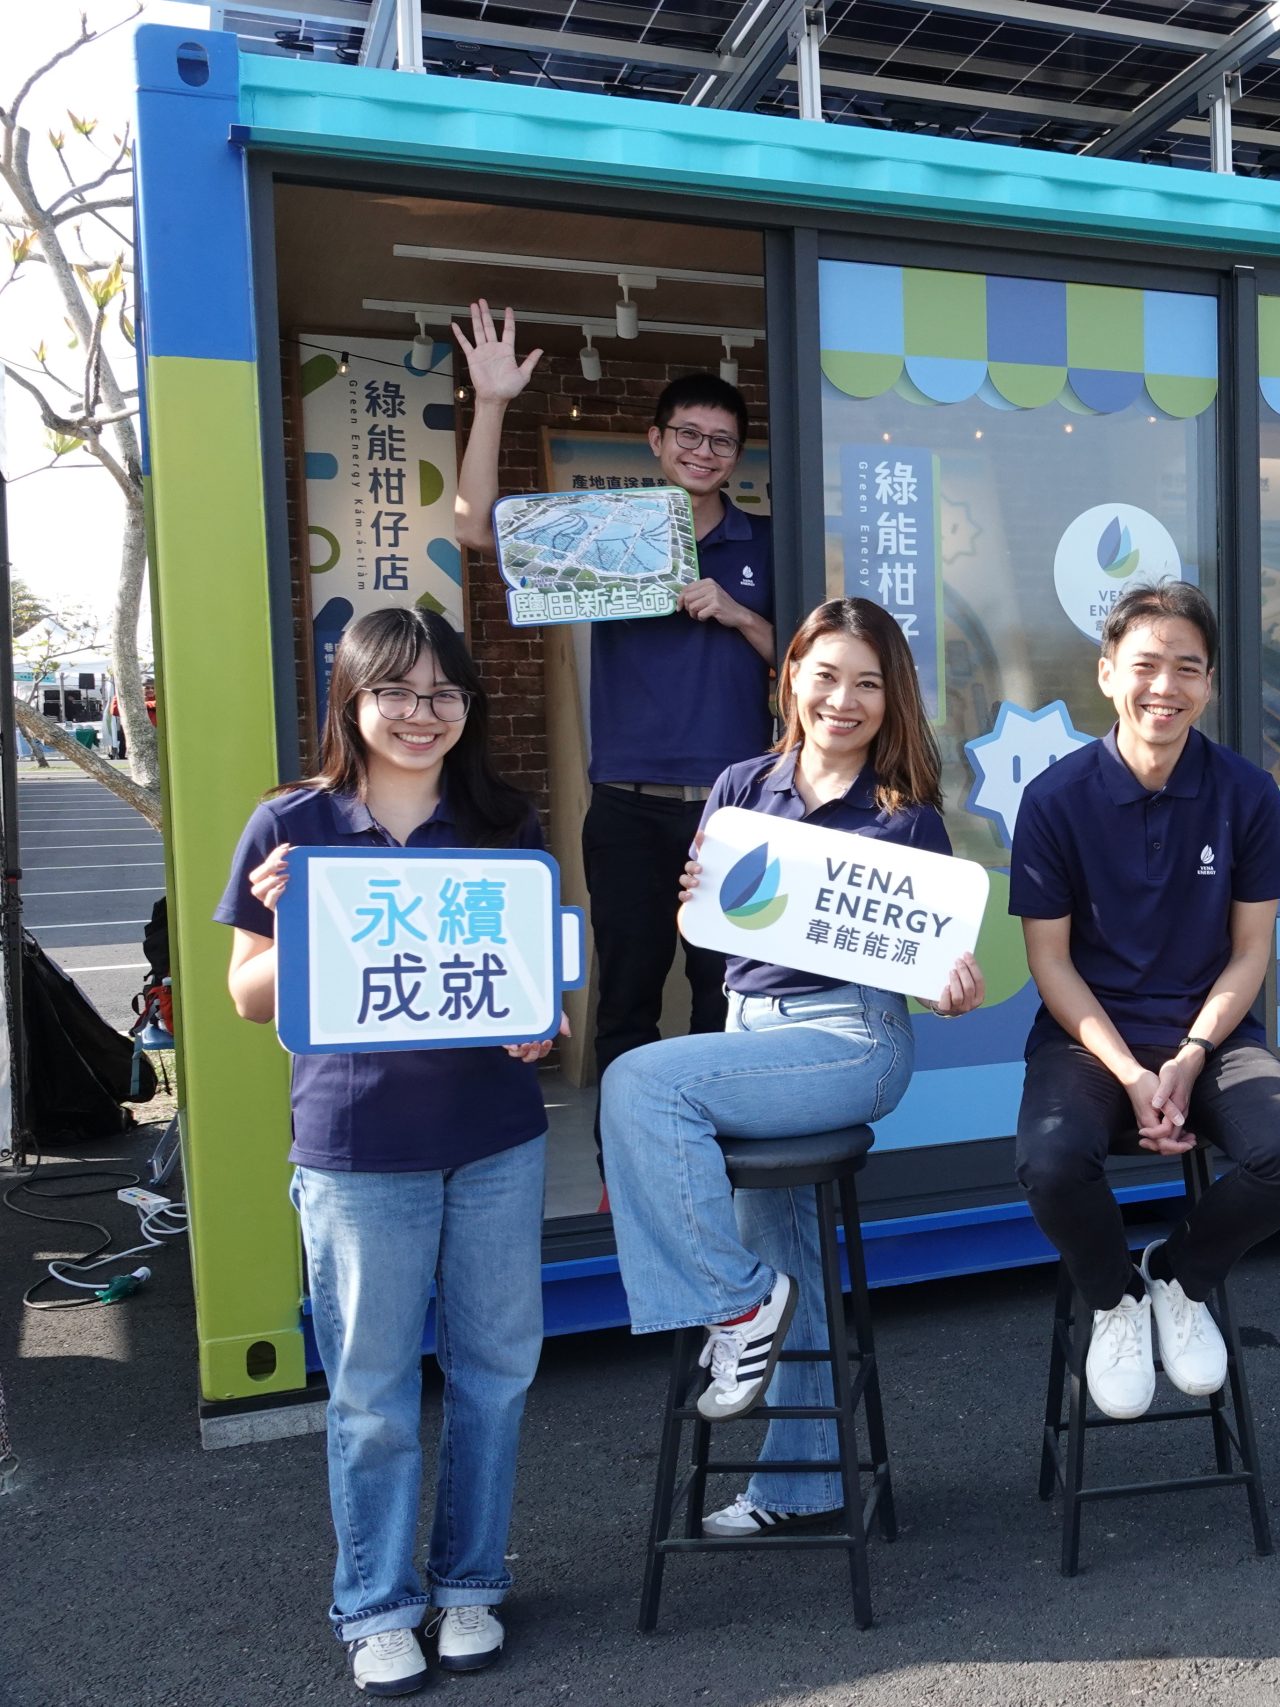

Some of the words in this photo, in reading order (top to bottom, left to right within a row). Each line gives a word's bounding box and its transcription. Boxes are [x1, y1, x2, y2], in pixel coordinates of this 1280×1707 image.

[349, 379, 359, 424] Green
[350, 434, 361, 488] Energy
[364, 379, 409, 591] 綠能柑仔店
[857, 461, 868, 513] Green
[859, 524, 870, 588] Energy
[875, 460, 920, 671] 綠能柑
[514, 583, 671, 622] 鹽田新生命
[825, 857, 915, 900] VENA
[351, 877, 508, 947] 永續
[814, 887, 953, 938] ENERGY
[805, 918, 921, 966] 韋能能源
[356, 952, 510, 1025] 成就
